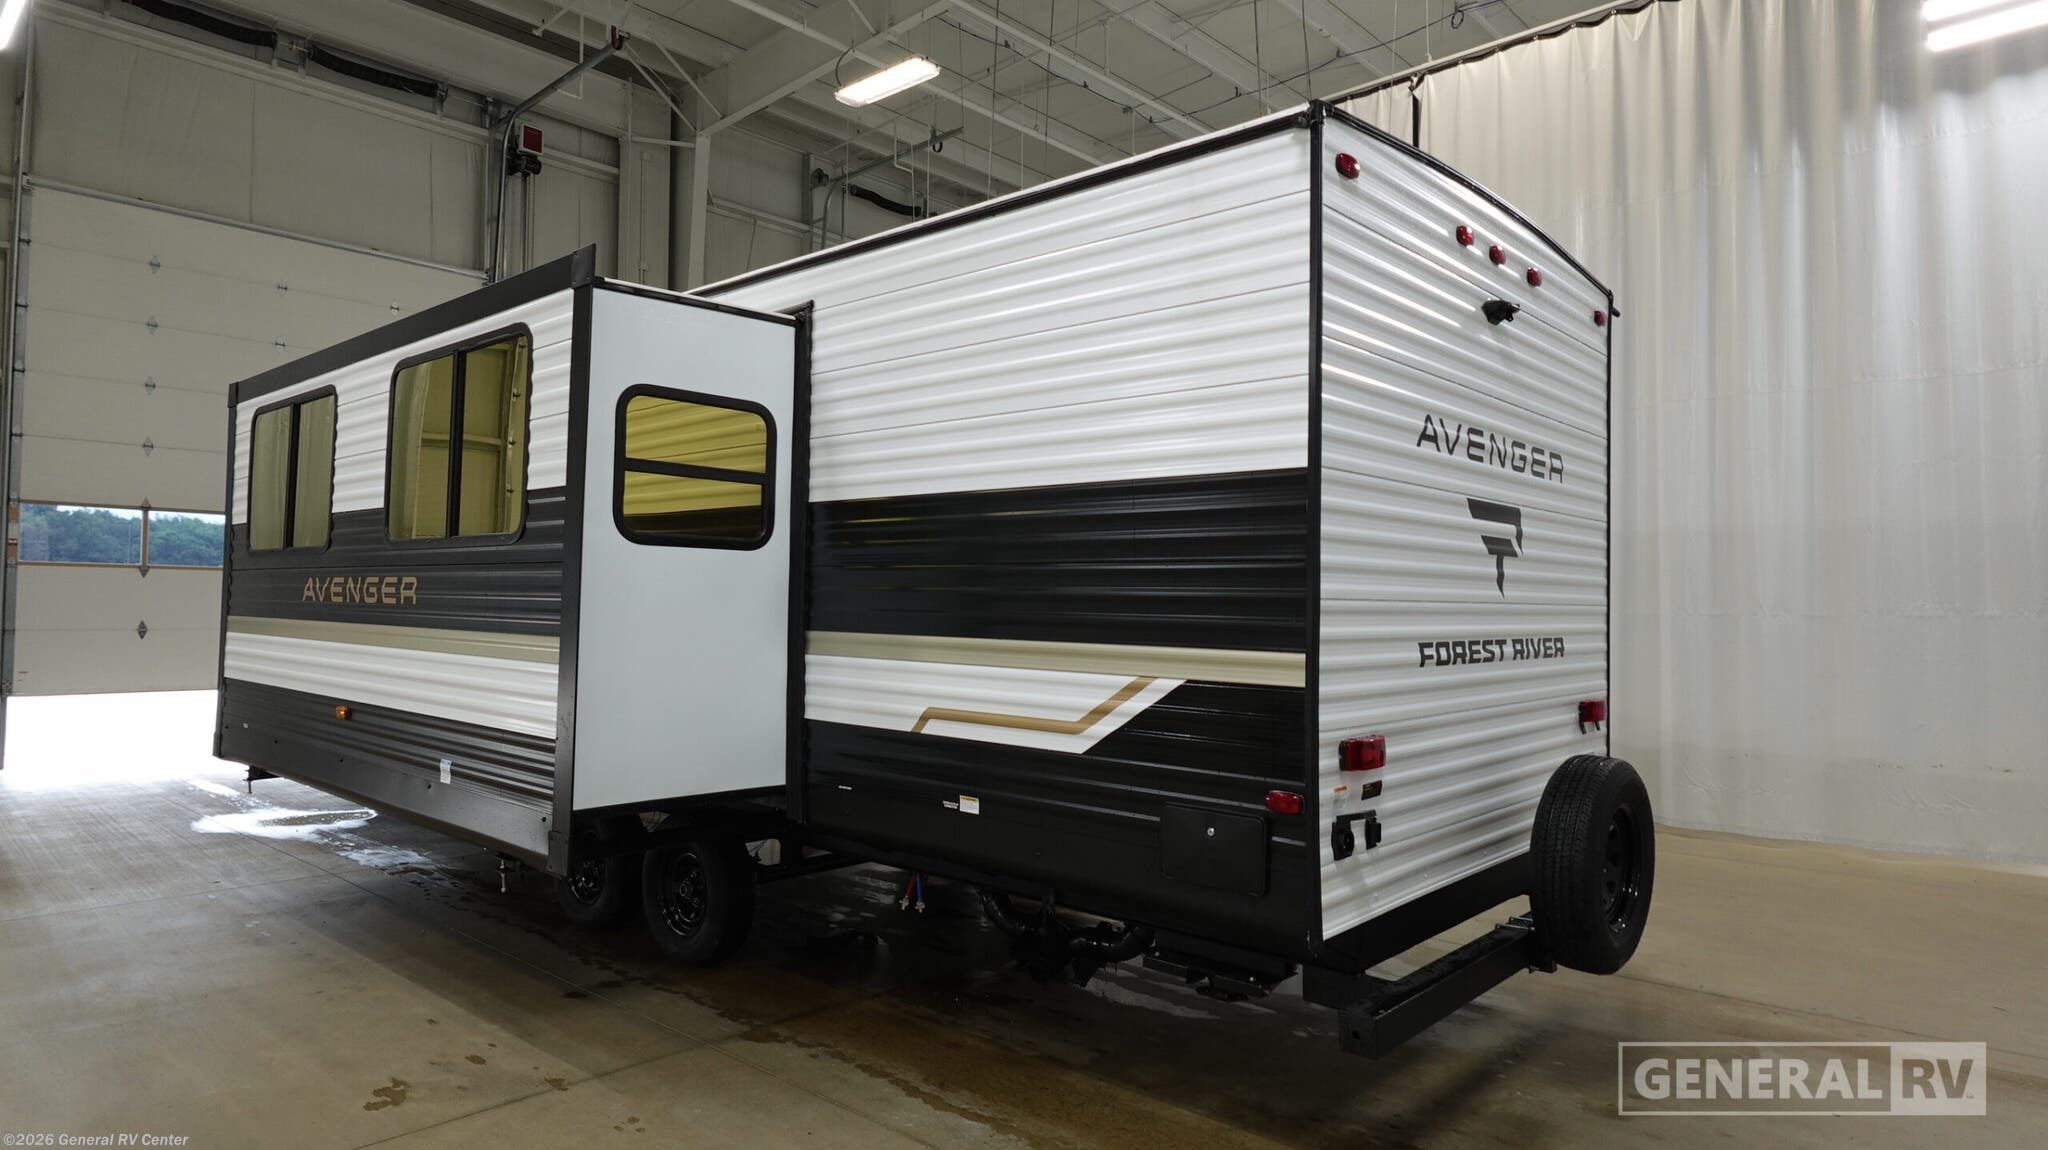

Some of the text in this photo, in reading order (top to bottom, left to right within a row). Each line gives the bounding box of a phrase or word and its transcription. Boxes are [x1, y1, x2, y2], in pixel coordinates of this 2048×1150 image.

[1416, 414, 1564, 483] AVENGER
[302, 576, 418, 605] AVENGER
[1418, 637, 1565, 668] FOREST RIVER
